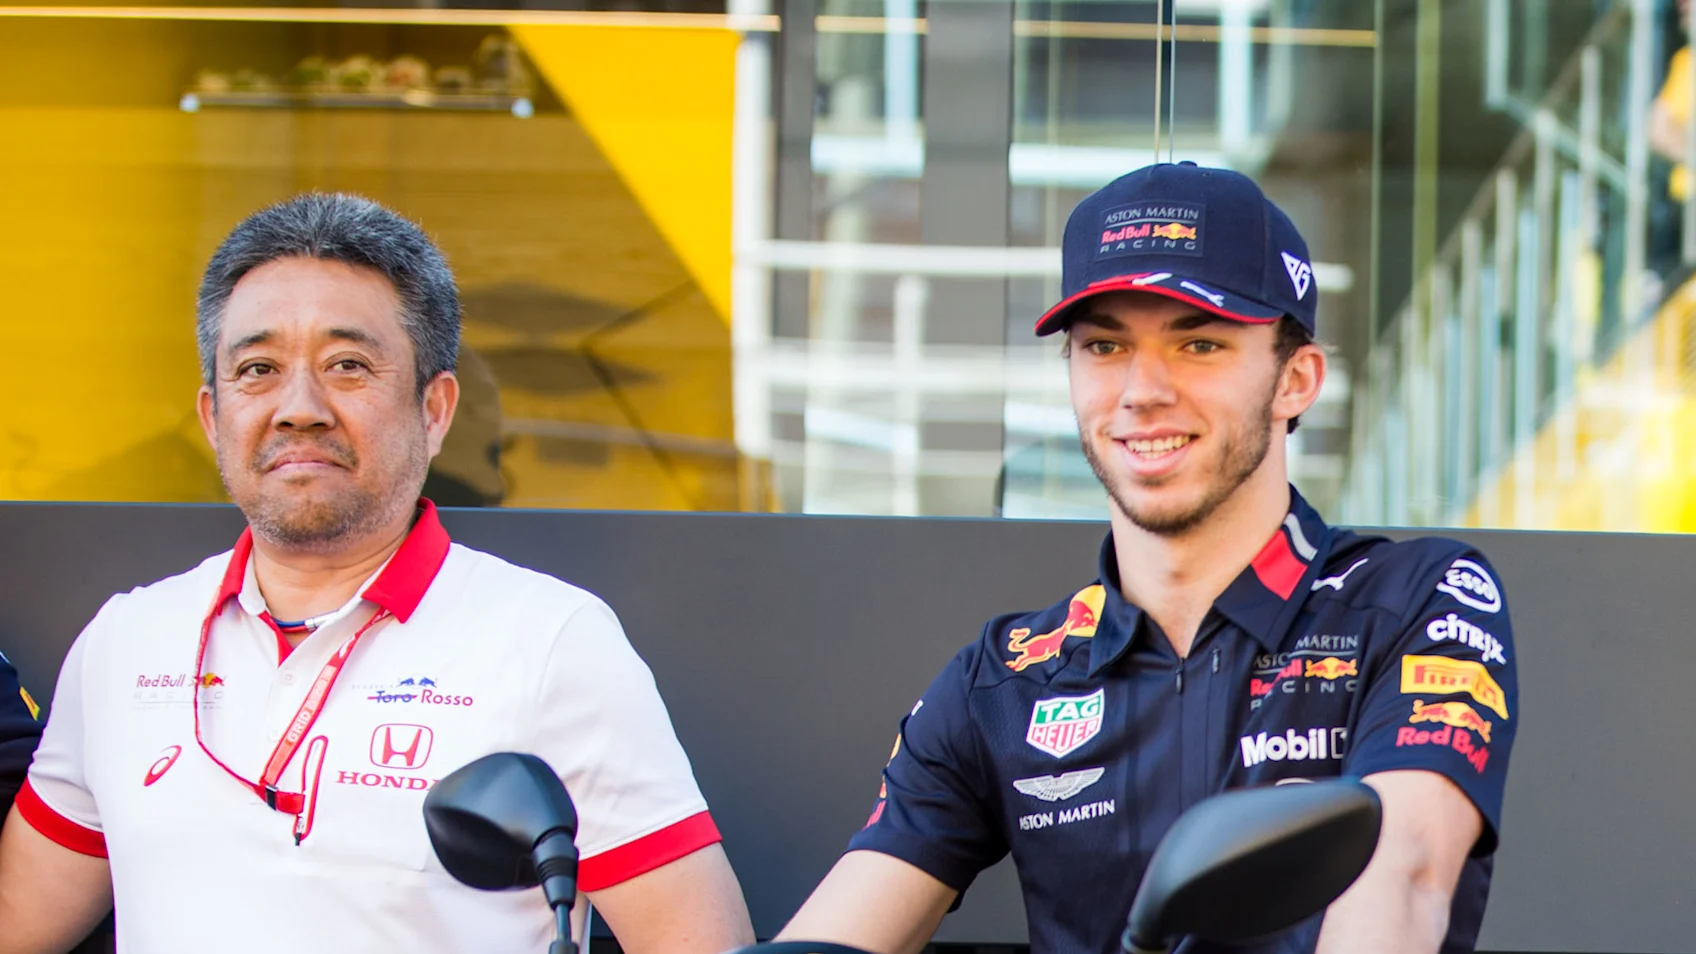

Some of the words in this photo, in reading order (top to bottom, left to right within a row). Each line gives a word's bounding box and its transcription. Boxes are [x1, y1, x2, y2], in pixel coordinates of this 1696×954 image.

[1104, 207, 1142, 225] ASTON
[1144, 206, 1199, 220] MARTIN
[1100, 239, 1197, 254] RACING
[1295, 634, 1359, 650] MARTIN
[376, 689, 413, 704] Toro
[420, 688, 474, 707] Rosso
[1040, 696, 1101, 724] TAG
[287, 709, 312, 743] GRID
[1032, 718, 1099, 751] HEUER
[1240, 727, 1327, 769] Mobil
[1058, 799, 1116, 825] MARTIN
